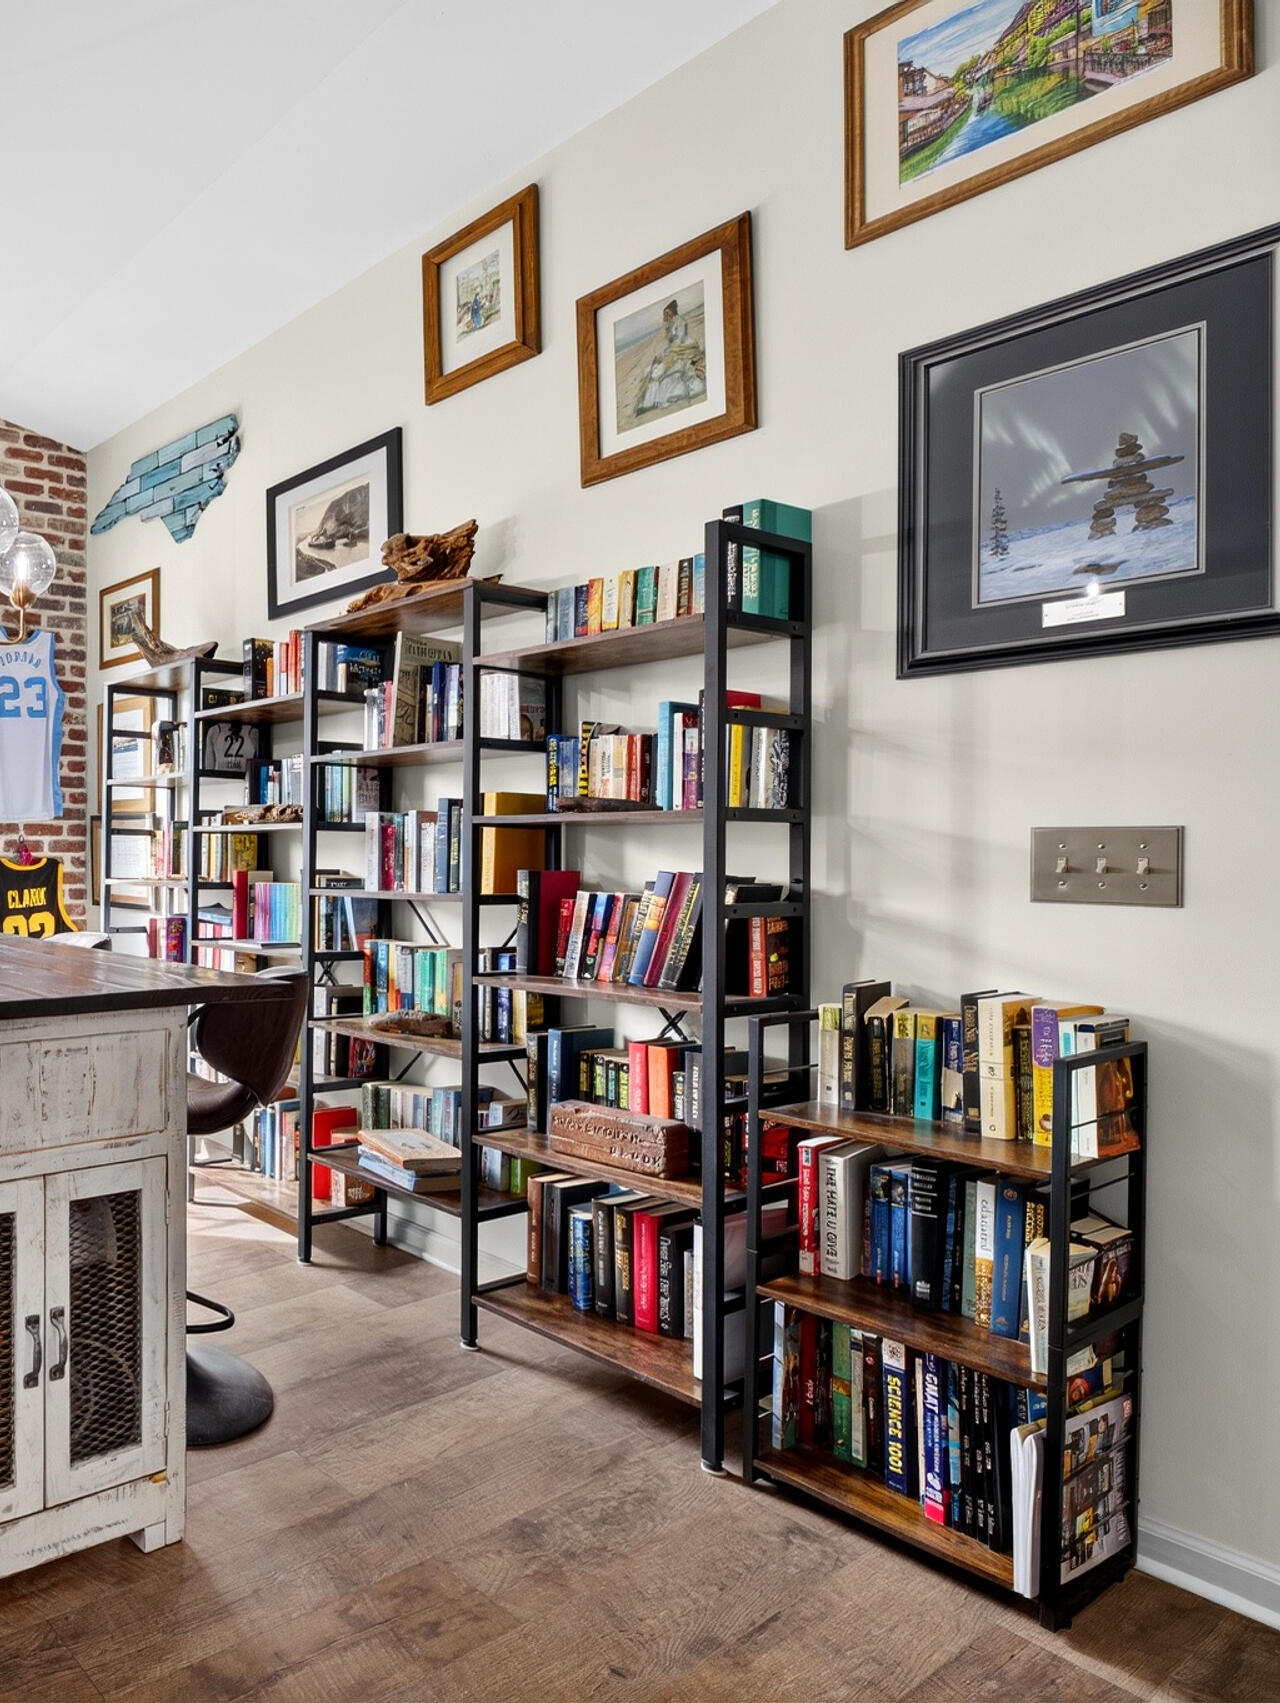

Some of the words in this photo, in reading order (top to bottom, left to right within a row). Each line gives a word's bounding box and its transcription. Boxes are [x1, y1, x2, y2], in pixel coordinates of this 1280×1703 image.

[224, 735, 244, 757] 22
[8, 887, 47, 908] CLARK
[826, 1167, 837, 1187] THE
[826, 1189, 838, 1219] HATE
[826, 1220, 837, 1229] U
[826, 1231, 838, 1257] GIVE
[887, 1374, 902, 1438] SCIENCE
[924, 1372, 939, 1414] GMAT
[888, 1442, 903, 1475] 1001
